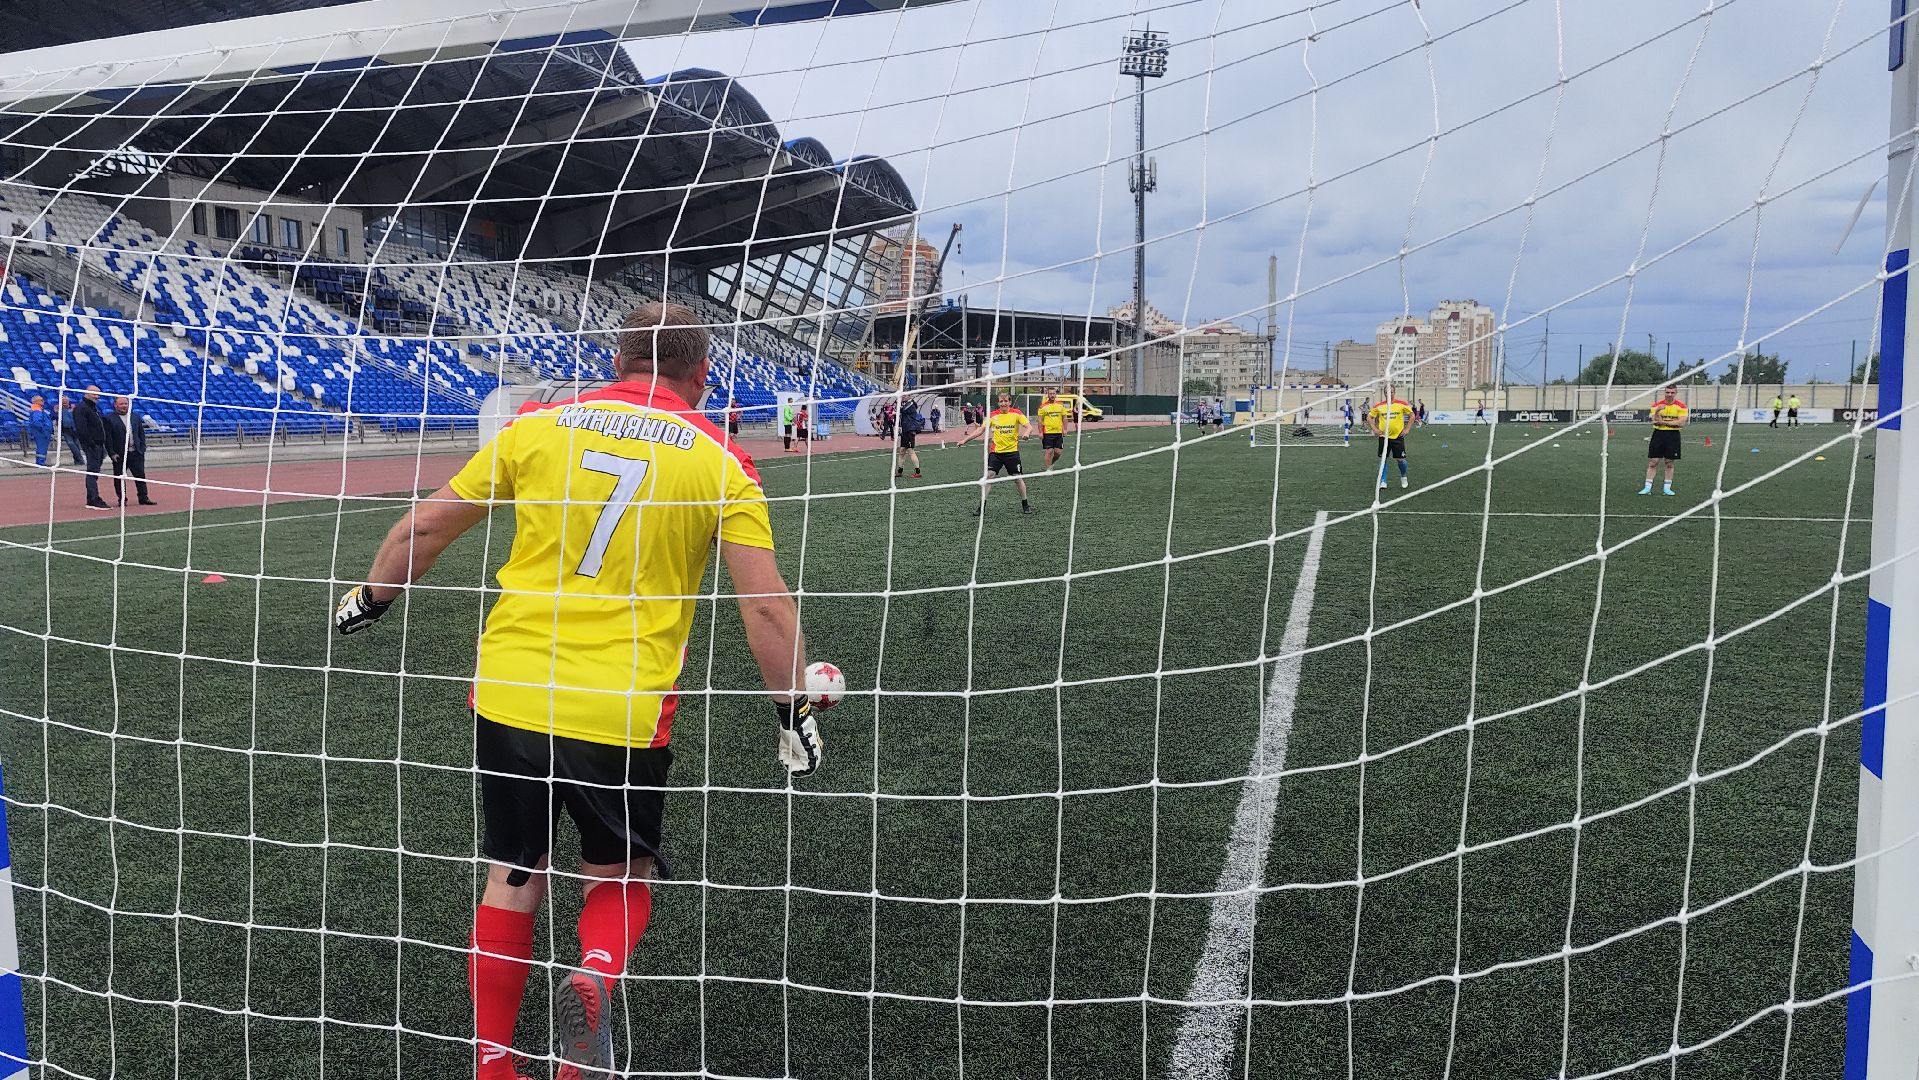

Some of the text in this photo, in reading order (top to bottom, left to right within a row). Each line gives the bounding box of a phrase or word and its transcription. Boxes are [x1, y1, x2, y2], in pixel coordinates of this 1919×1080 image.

[556, 406, 696, 450] КИНДЯШОВ
[1510, 411, 1558, 422] JÖGEL
[575, 449, 649, 578] 7
